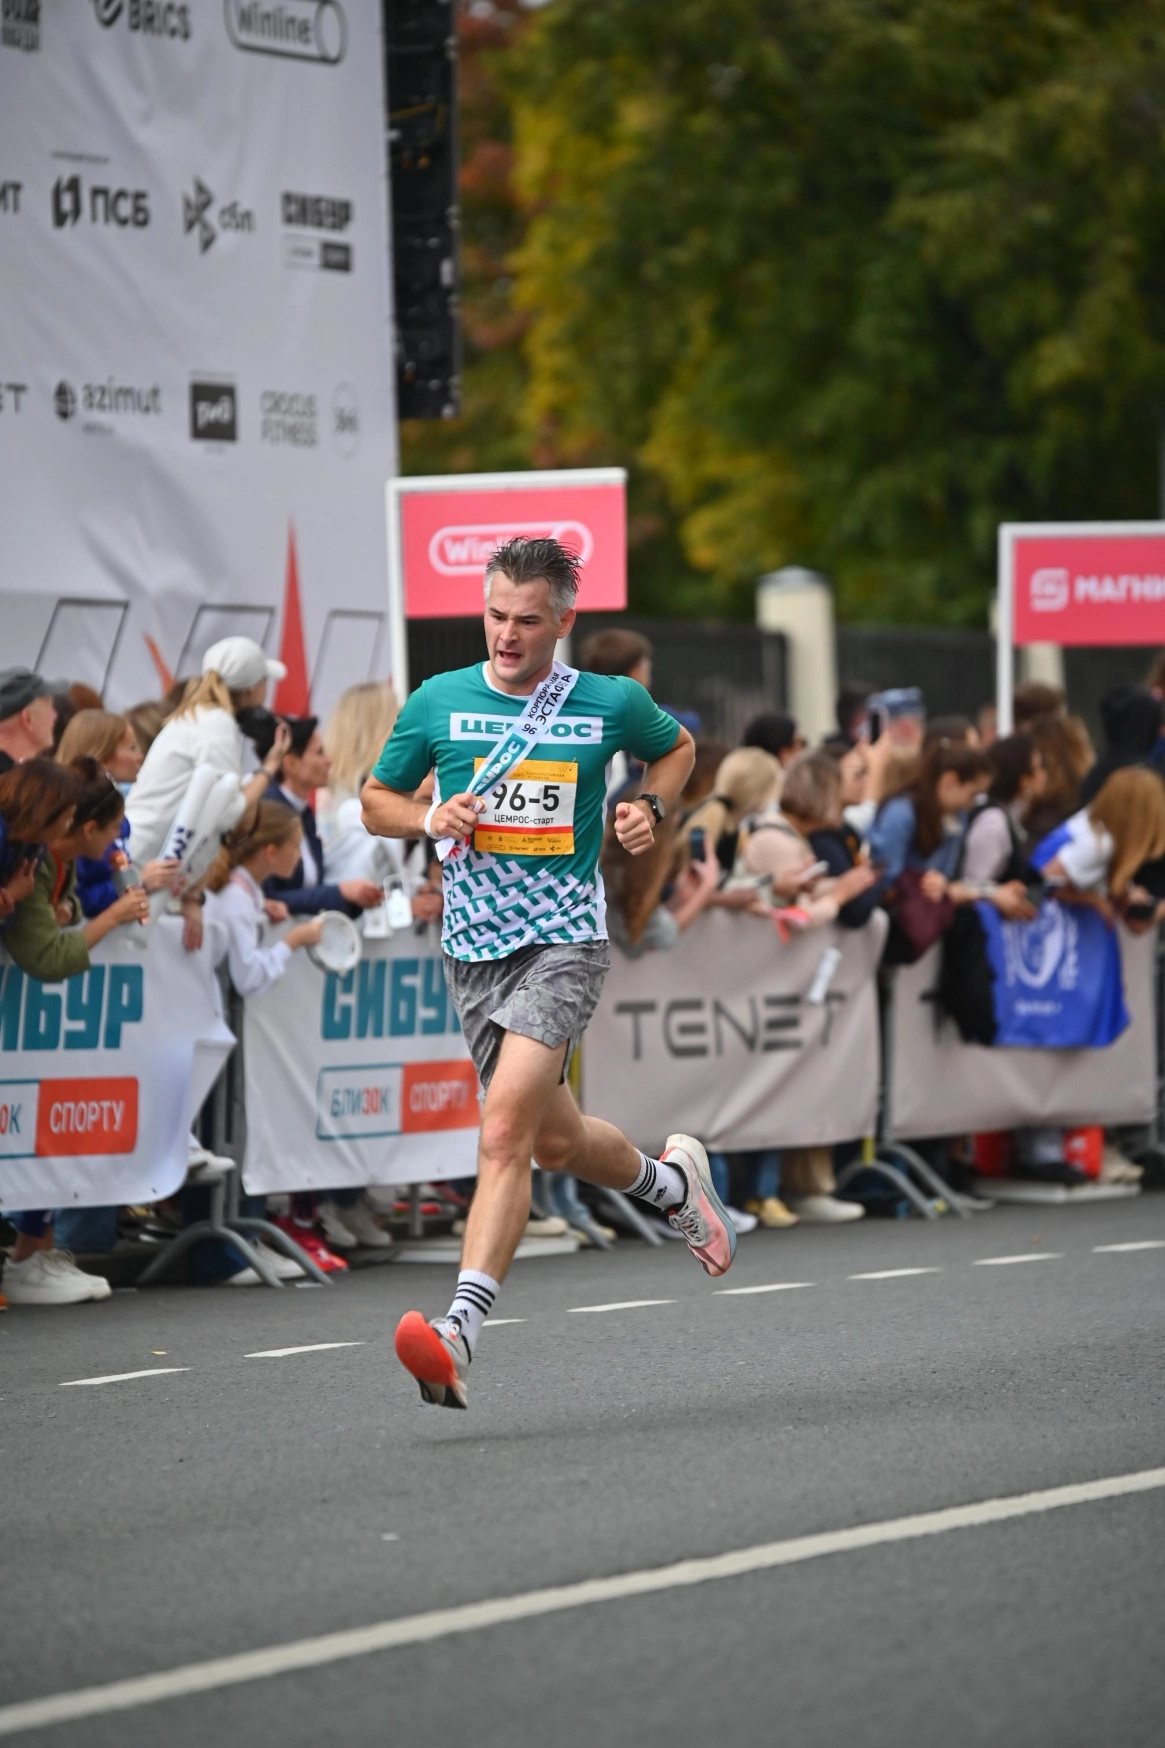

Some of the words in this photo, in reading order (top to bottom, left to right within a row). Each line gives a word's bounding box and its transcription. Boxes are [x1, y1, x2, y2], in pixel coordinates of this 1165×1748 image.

[129, 0, 191, 41] BRICS
[234, 1, 311, 45] Winline
[91, 186, 150, 228] ПСБ
[82, 377, 161, 415] azimut
[461, 719, 592, 737] ЦЕОС
[522, 723, 538, 735] 96
[492, 783, 560, 811] 96-5
[494, 814, 554, 825] ЦЕМРОС-старт
[322, 956, 464, 1040] СИБУ
[615, 992, 846, 1060] TENET
[409, 1080, 469, 1113] СПОРТУ
[50, 1100, 125, 1133] СПОРТУ
